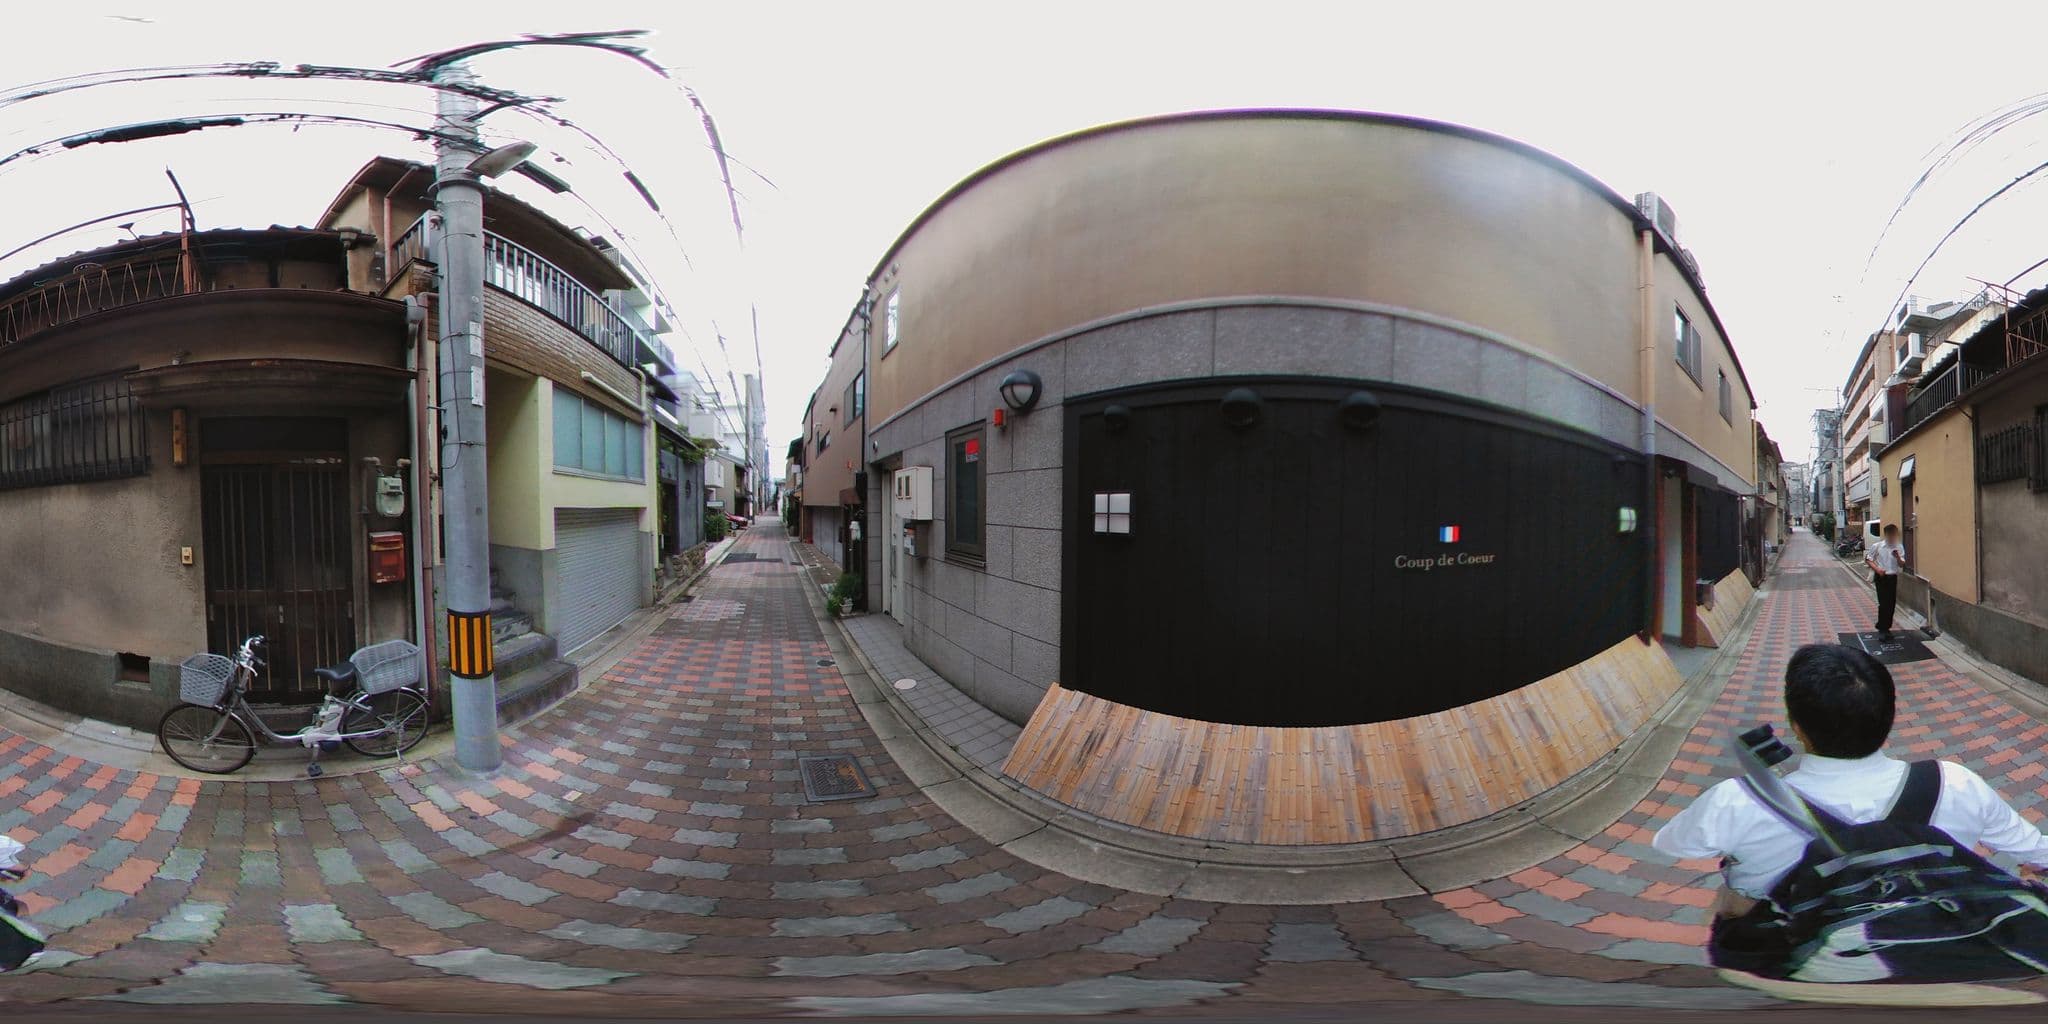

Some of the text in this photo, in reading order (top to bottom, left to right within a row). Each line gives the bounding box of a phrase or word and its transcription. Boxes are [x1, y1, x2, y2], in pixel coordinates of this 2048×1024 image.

[1395, 552, 1495, 571] Coup de Coeur
